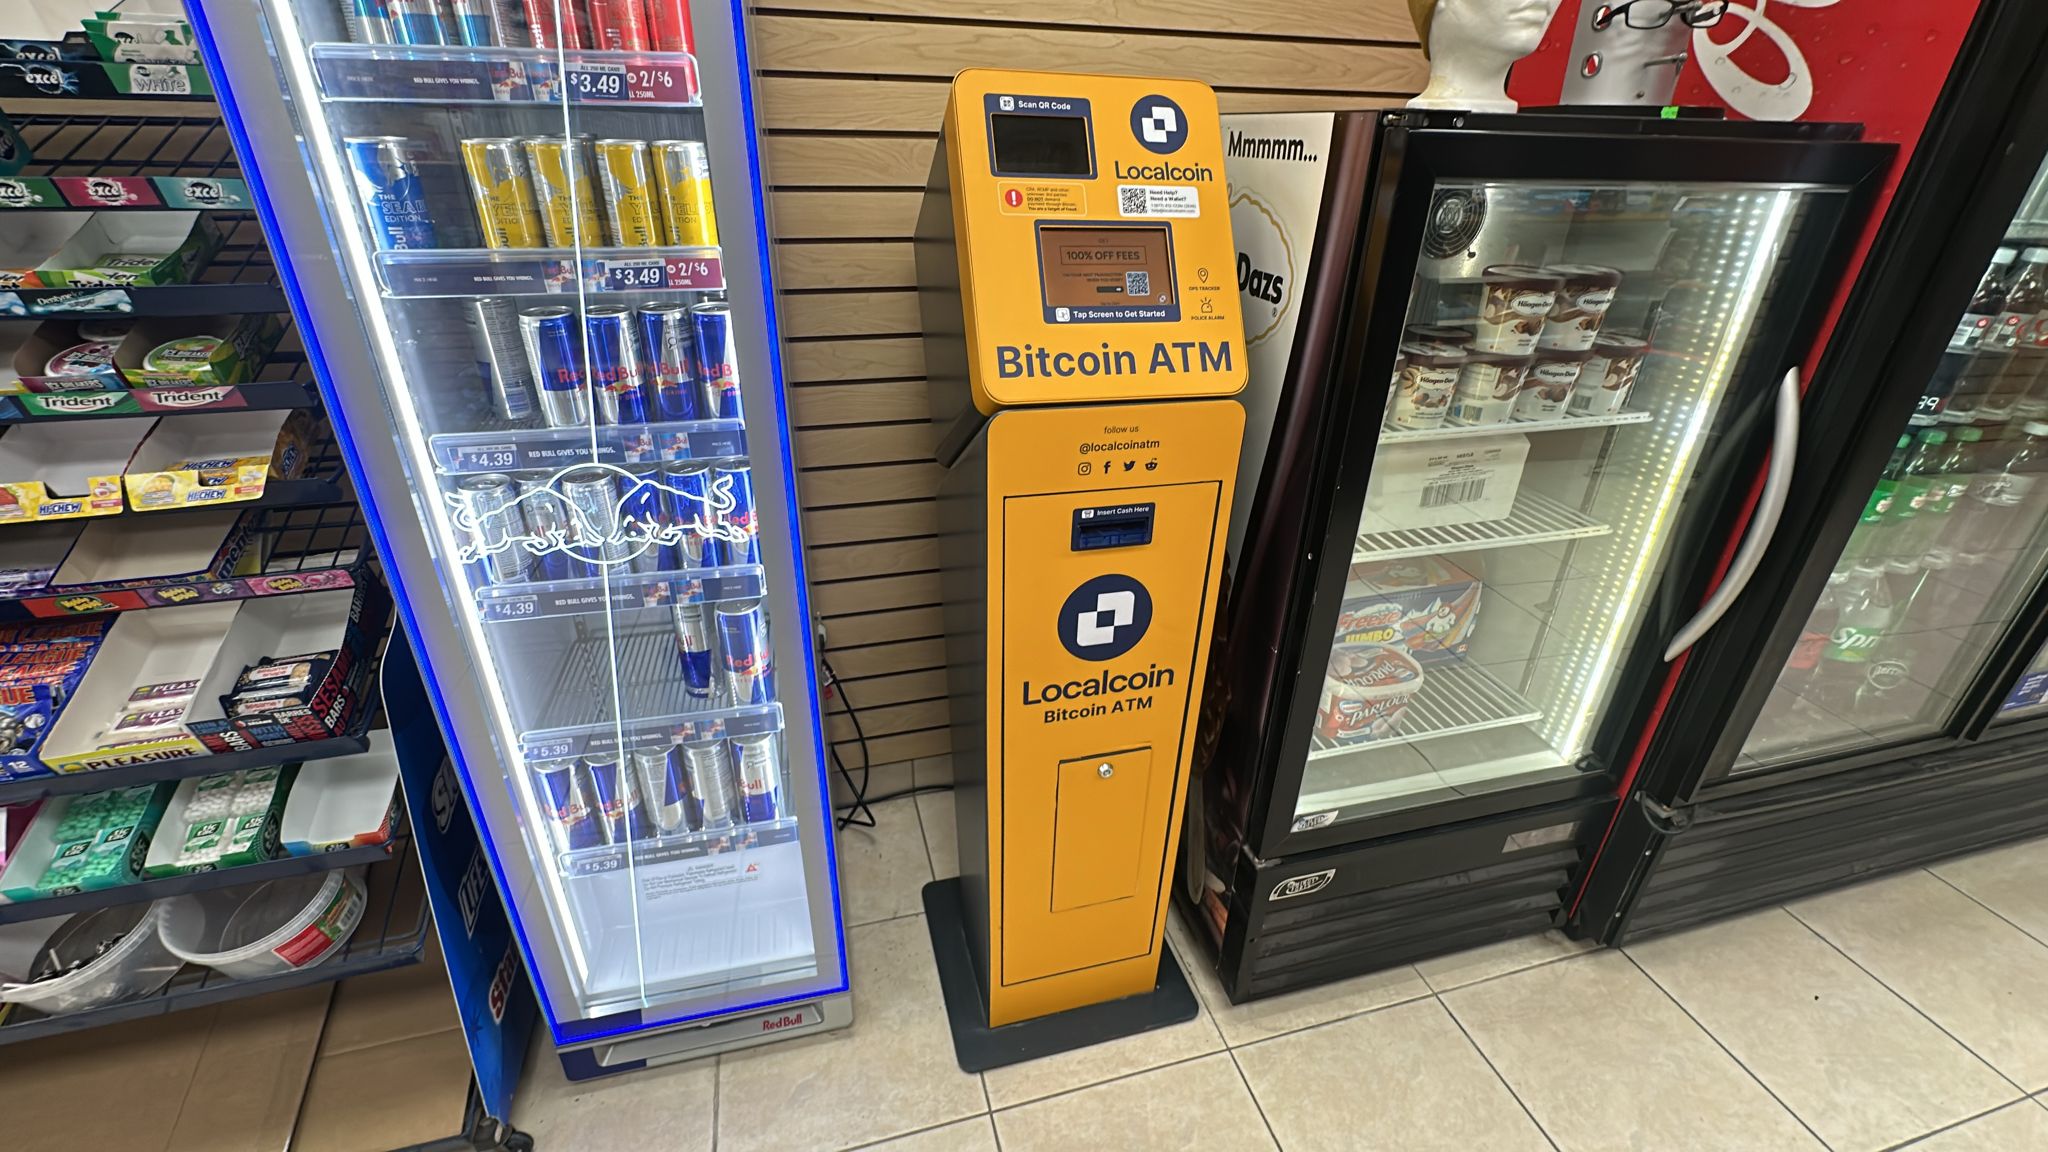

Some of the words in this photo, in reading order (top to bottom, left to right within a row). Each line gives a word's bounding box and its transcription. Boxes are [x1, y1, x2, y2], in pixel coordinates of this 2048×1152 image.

[25, 69, 64, 84] excel
[570, 72, 620, 94] $3.49
[640, 70, 673, 88] 2/$6
[1018, 100, 1037, 109] Scan
[1038, 101, 1050, 109] QR
[1051, 101, 1071, 110] Code
[1227, 130, 1318, 163] Mmmmm...
[1114, 160, 1213, 182] Localcoin
[89, 181, 124, 196] excel
[184, 182, 224, 198] excel
[1066, 251, 1092, 261] 100%
[1094, 251, 1114, 260] OFF
[1116, 251, 1140, 260] FEES
[615, 267, 660, 285] $3.49
[678, 262, 709, 276] 2/$6
[1517, 300, 1553, 309] Häagen-Da
[1073, 311, 1087, 319] Tap
[1139, 310, 1166, 318] Started
[997, 342, 1137, 379] Bitcoin
[1149, 341, 1233, 374] ATM
[1419, 376, 1454, 385] Häagen-Da
[40, 396, 112, 408] Trident
[153, 390, 221, 404] Trident
[1104, 425, 1128, 434] follow
[1129, 425, 1139, 433] us
[1079, 440, 1160, 455] @localcoinatm
[471, 452, 513, 467] $4.39
[186, 489, 227, 501] HI-CHEW
[39, 502, 82, 516] HI-CHEW
[1097, 508, 1116, 516] Insert
[495, 602, 534, 616] $4.39
[1022, 664, 1174, 705] Localcoin
[324, 694, 346, 729] BARS
[1044, 704, 1107, 723] Bitcoin
[1111, 696, 1153, 713] ATM
[533, 744, 569, 757] $5.39
[86, 747, 199, 771] PLEASURE
[585, 859, 618, 872] $5.39
[763, 1017, 782, 1031] Red
[783, 1013, 802, 1027] Bull
